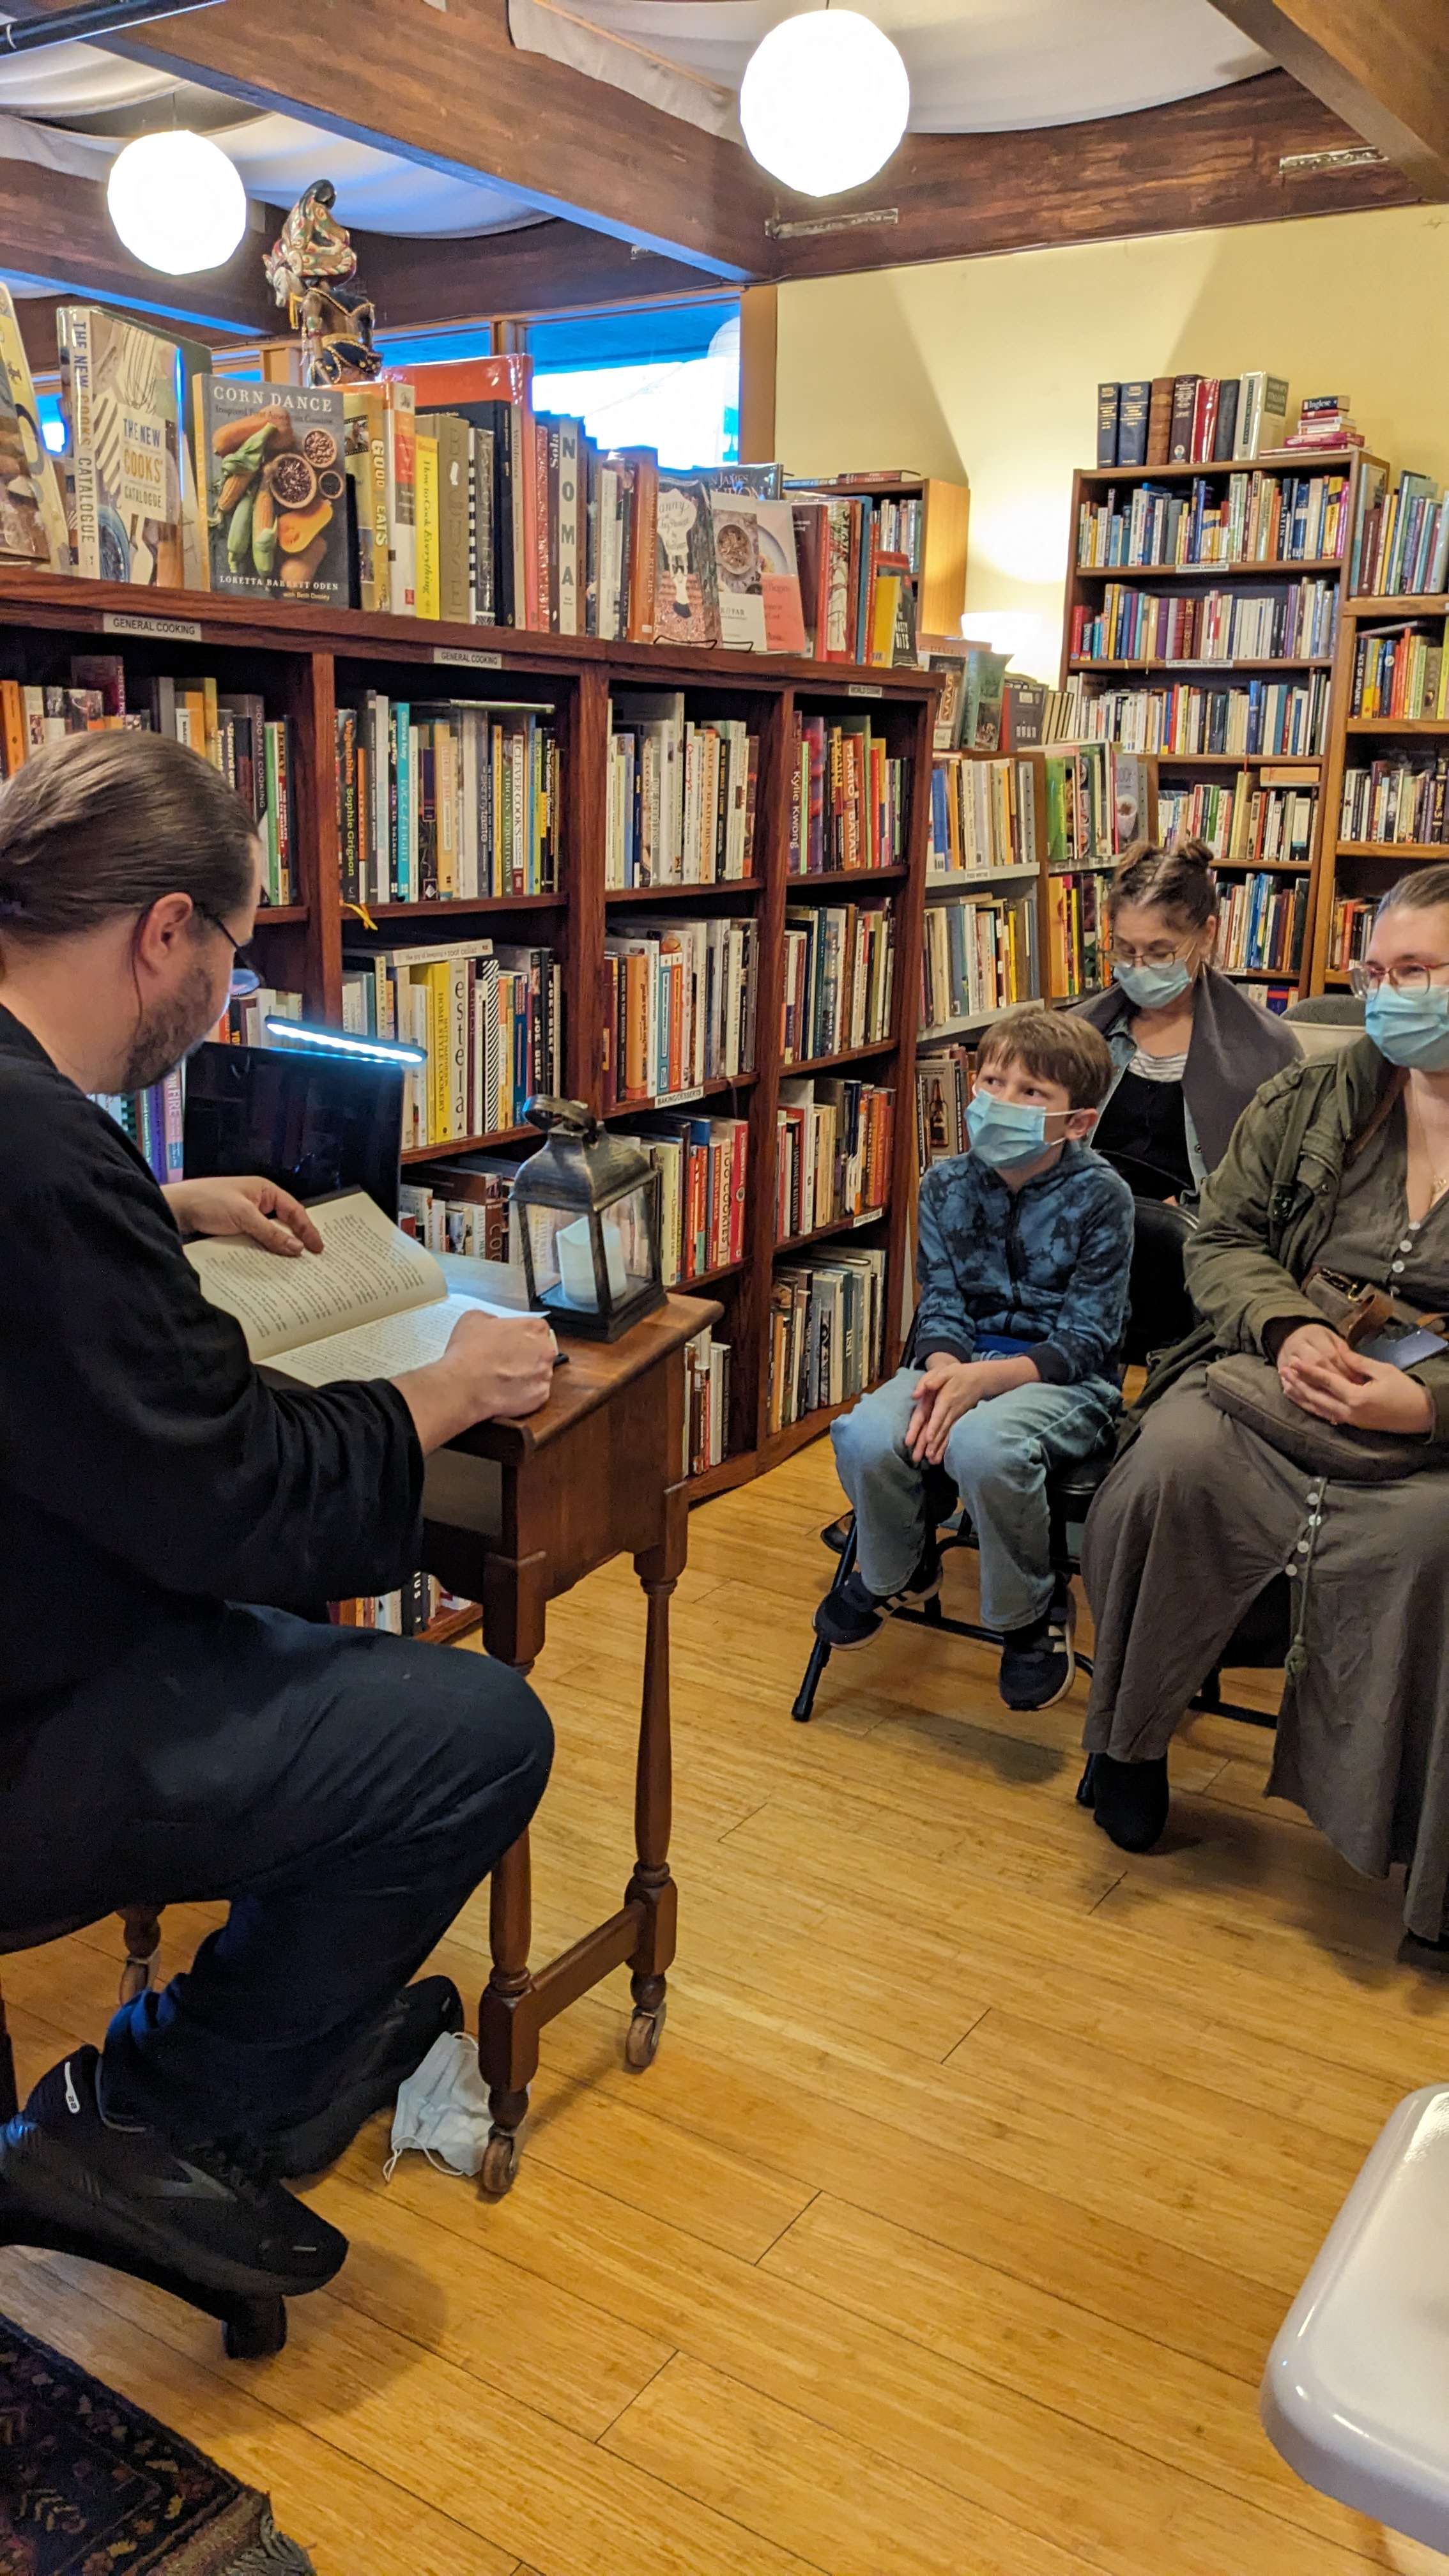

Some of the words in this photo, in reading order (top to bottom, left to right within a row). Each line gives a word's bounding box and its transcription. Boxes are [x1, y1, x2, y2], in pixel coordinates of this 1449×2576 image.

[73, 322, 86, 349] THE
[74, 356, 89, 388] NEW
[213, 386, 264, 404] CORN
[270, 393, 332, 412] DANCE
[123, 417, 139, 440] THE
[139, 426, 161, 448] NEW
[123, 448, 164, 484] COOKS'
[78, 457, 95, 542] CATALOGUE
[123, 485, 162, 509] CATALOGUE
[562, 436, 576, 586] NOMA
[375, 504, 388, 548] EATS
[422, 530, 433, 595] Everything
[220, 575, 263, 586] LORETTA
[266, 579, 309, 589] BARRETT
[313, 582, 339, 591] ODEN
[113, 618, 155, 632] GENERAL
[156, 622, 195, 635] COOKING
[441, 651, 470, 662] GENERAL
[471, 654, 498, 664] COOKING
[345, 719, 354, 785] Vegetables
[514, 746, 523, 791] CLEVER
[257, 760, 266, 809] COOKING
[791, 770, 801, 802] Kylie
[346, 787, 355, 829] Sophie
[790, 805, 801, 850] Kwong
[347, 829, 355, 877] Grigson
[455, 981, 464, 1114] estela
[167, 1089, 180, 1117] FIRE
[657, 1089, 702, 1106] BAKING/DESSERTS
[721, 1183, 730, 1243] COOKIES
